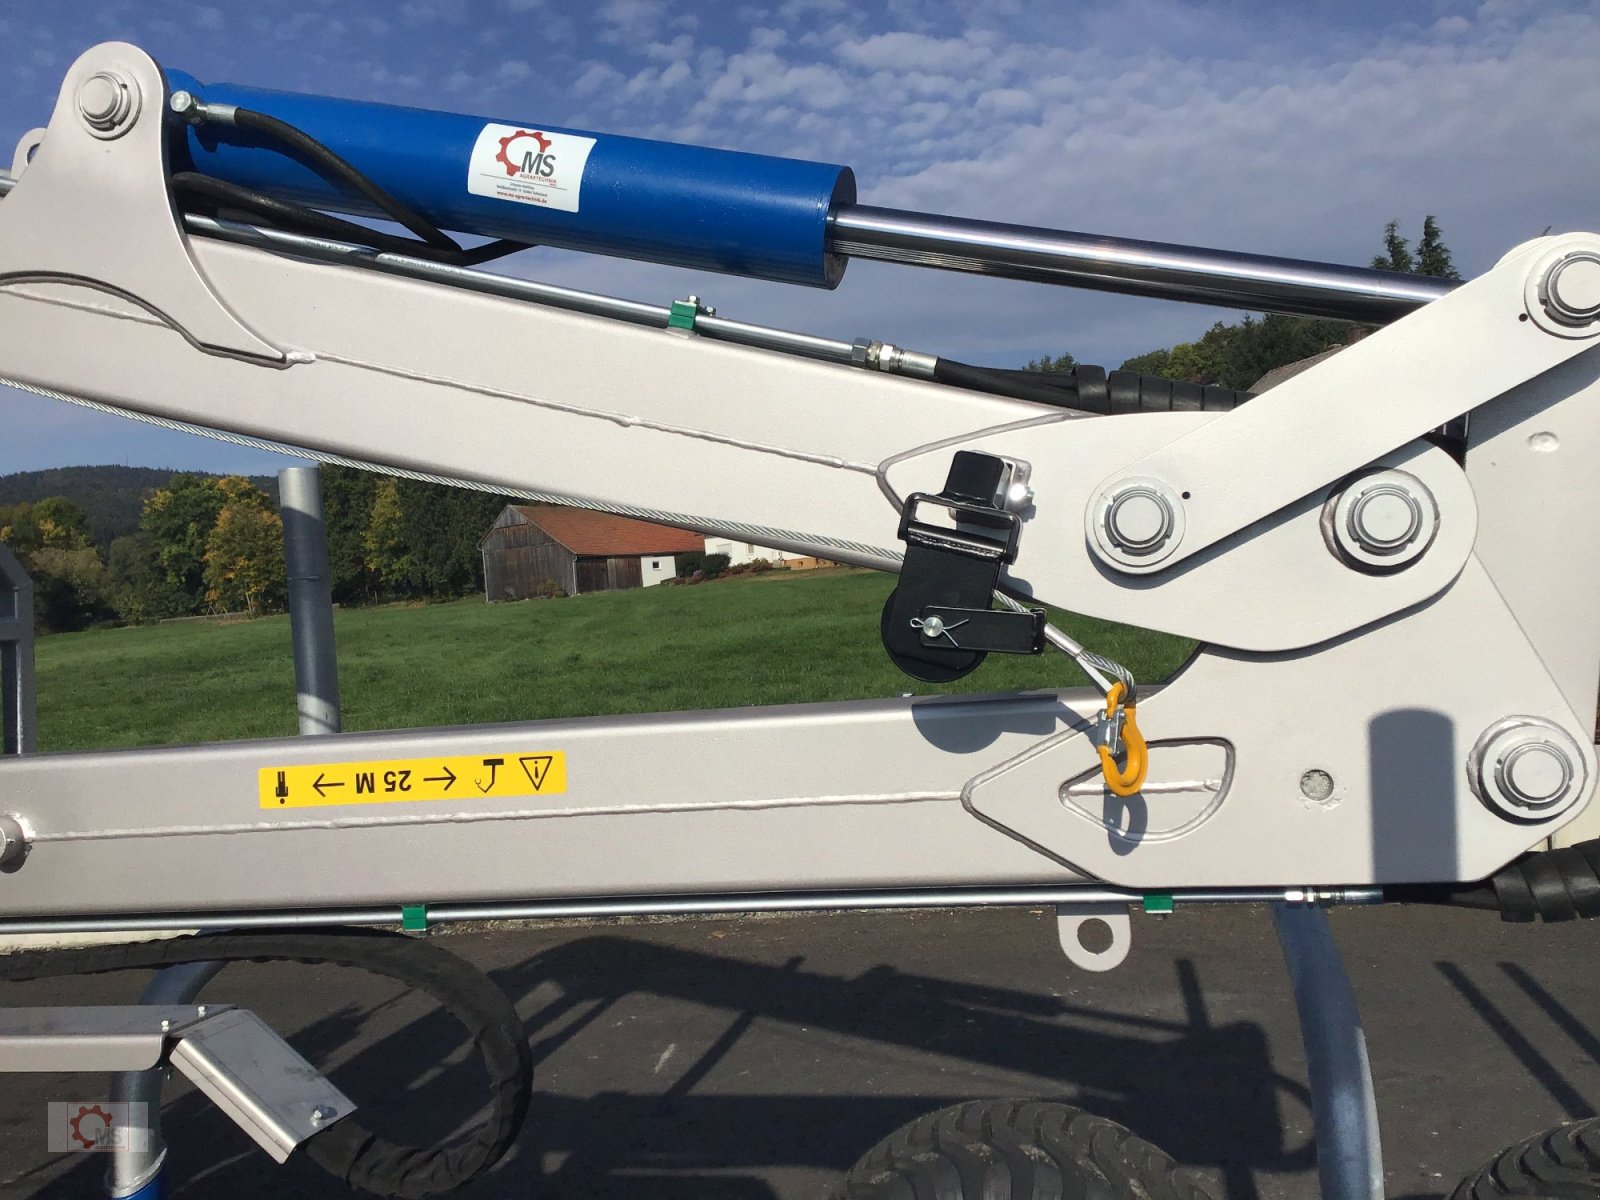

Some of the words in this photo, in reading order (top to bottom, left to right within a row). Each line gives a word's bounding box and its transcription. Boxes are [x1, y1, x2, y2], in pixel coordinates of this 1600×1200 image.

[520, 173, 557, 184] AGRARTECHNIK
[356, 772, 375, 794] M
[384, 770, 412, 792] 25
